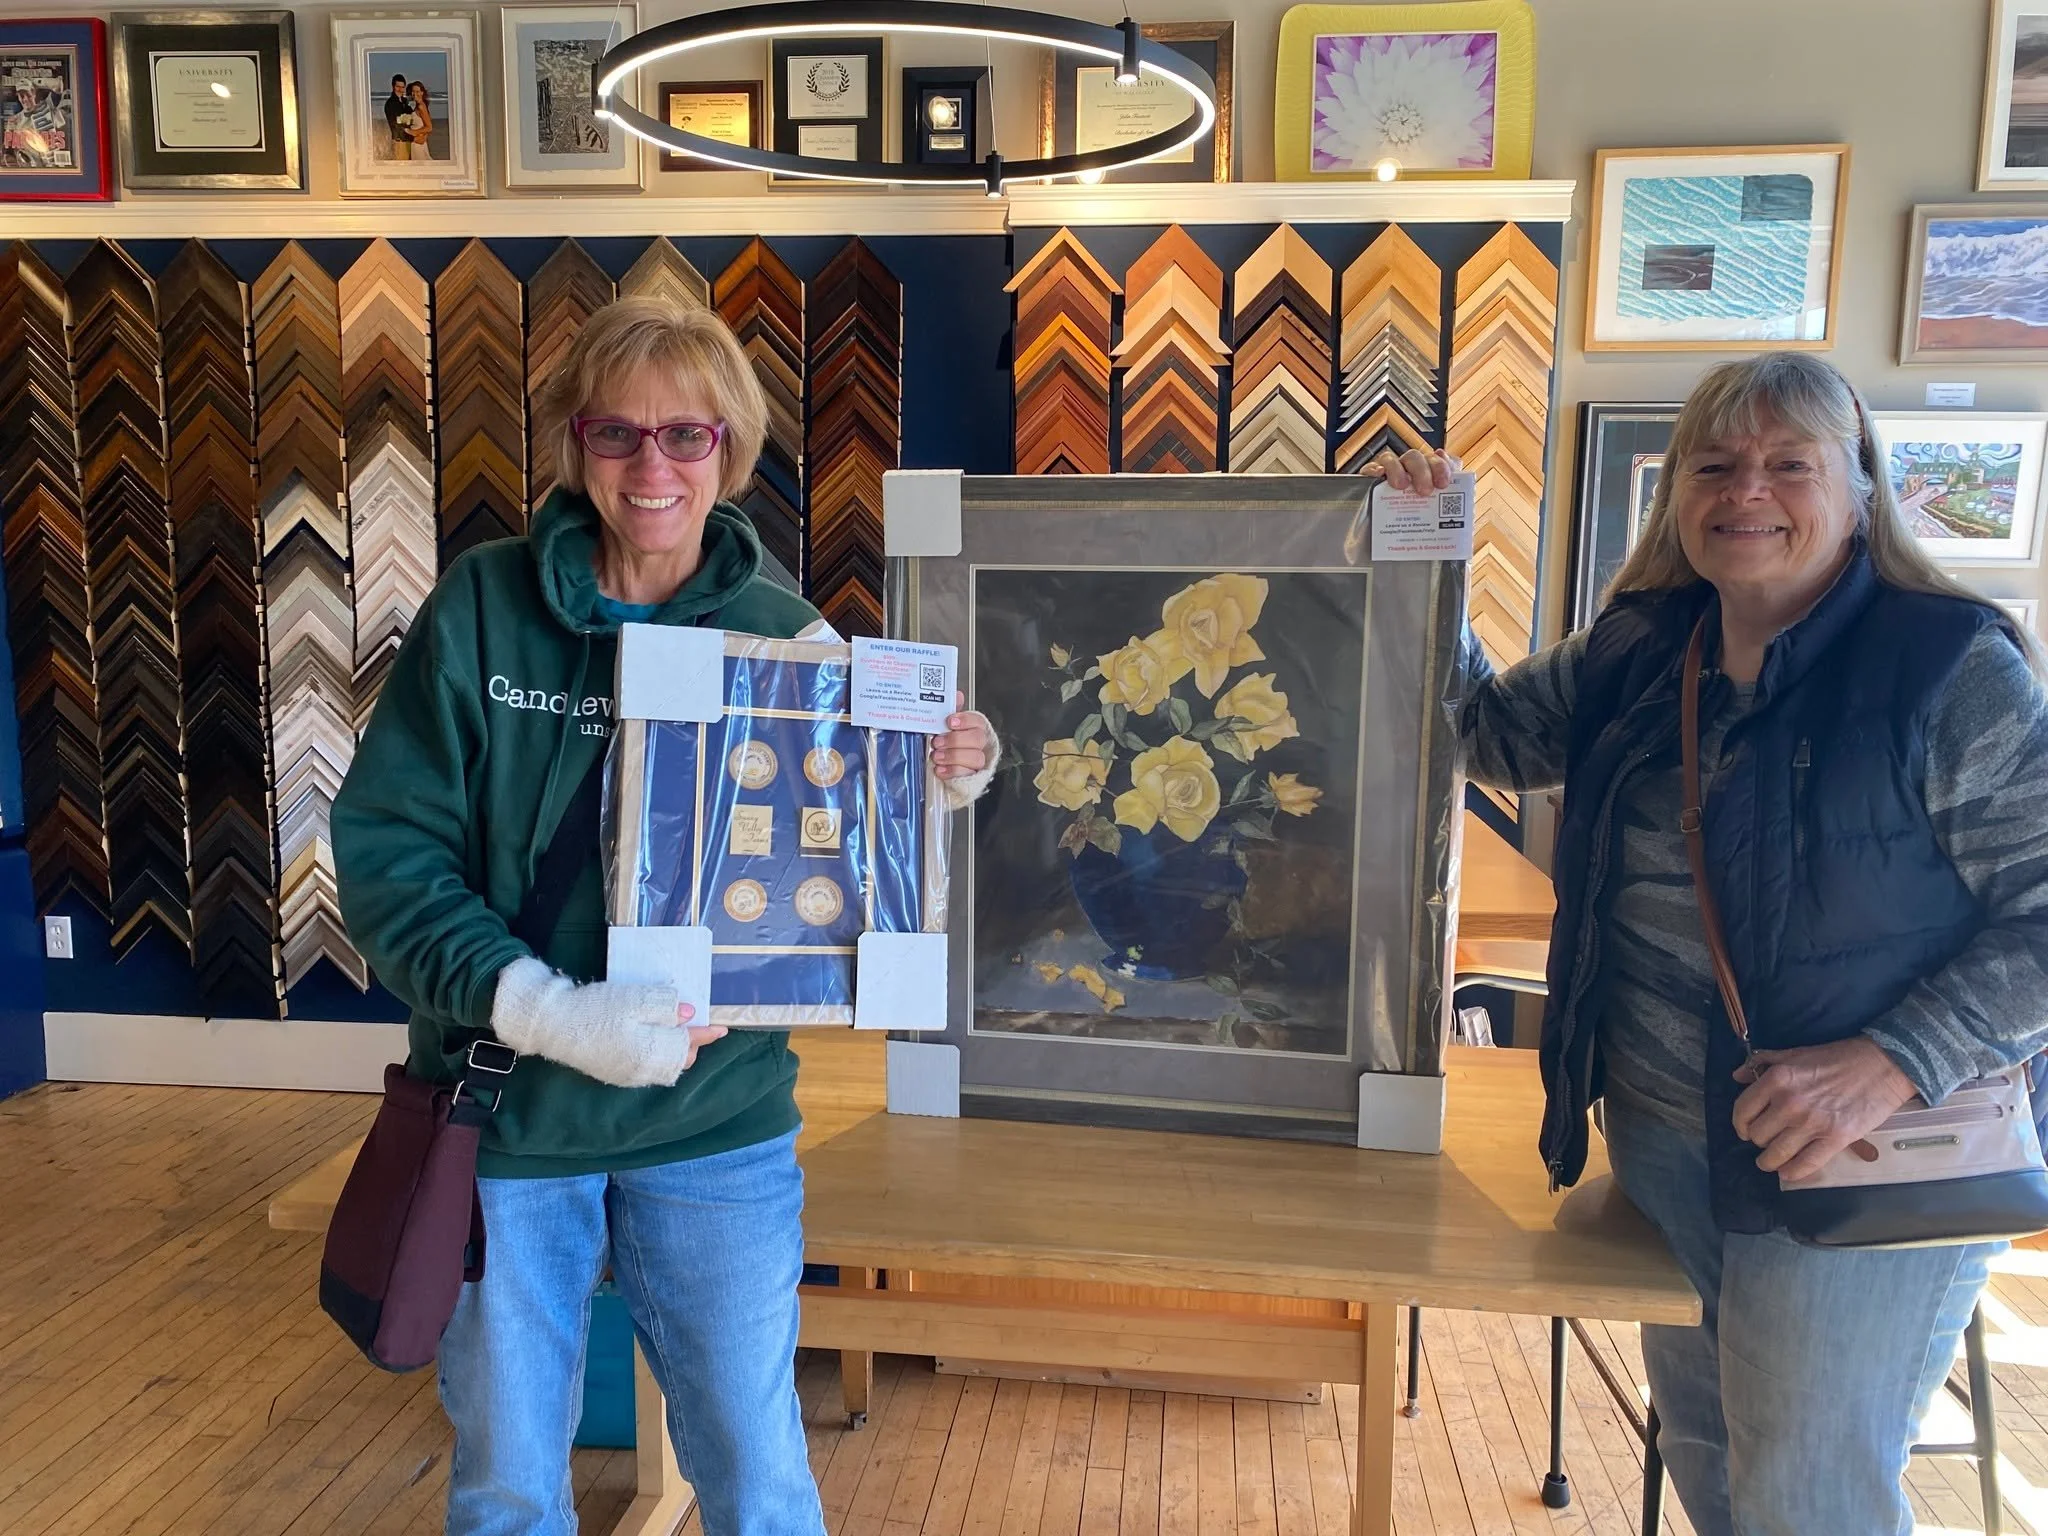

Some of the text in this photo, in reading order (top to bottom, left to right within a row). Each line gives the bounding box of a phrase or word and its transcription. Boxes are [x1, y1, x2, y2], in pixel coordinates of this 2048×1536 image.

[870, 644, 940, 657] ENTER OUR RAFFLE!
